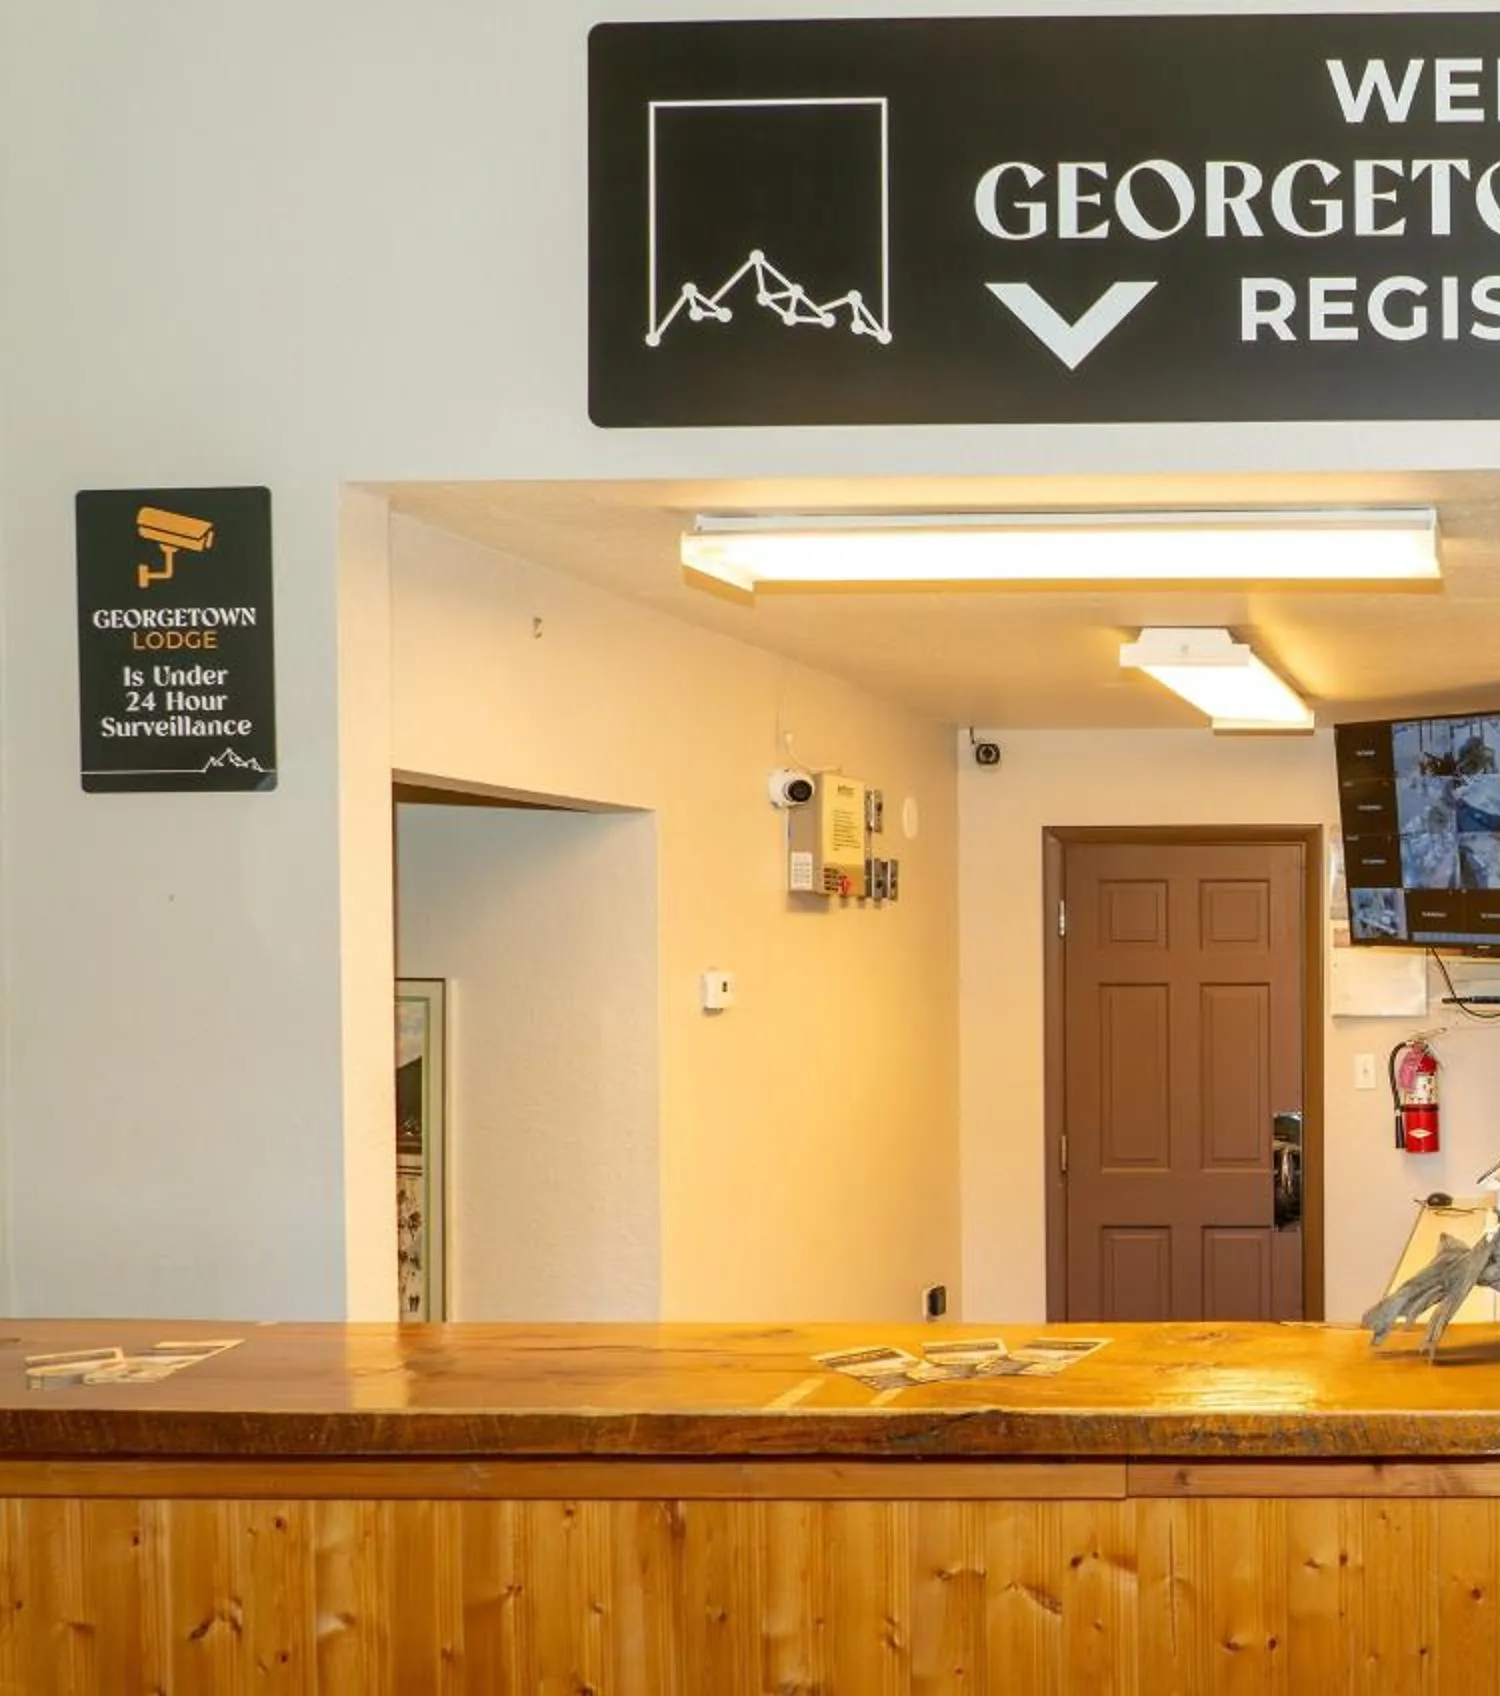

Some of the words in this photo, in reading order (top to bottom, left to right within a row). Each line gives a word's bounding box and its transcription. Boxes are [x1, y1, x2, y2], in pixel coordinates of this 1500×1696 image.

[92, 606, 257, 630] GEORGETOWN
[132, 630, 218, 650] LODGE
[122, 665, 146, 687] Is
[152, 664, 229, 687] Under
[125, 691, 158, 712] 24
[165, 690, 229, 711] Hour
[100, 713, 253, 738] Surveillance
